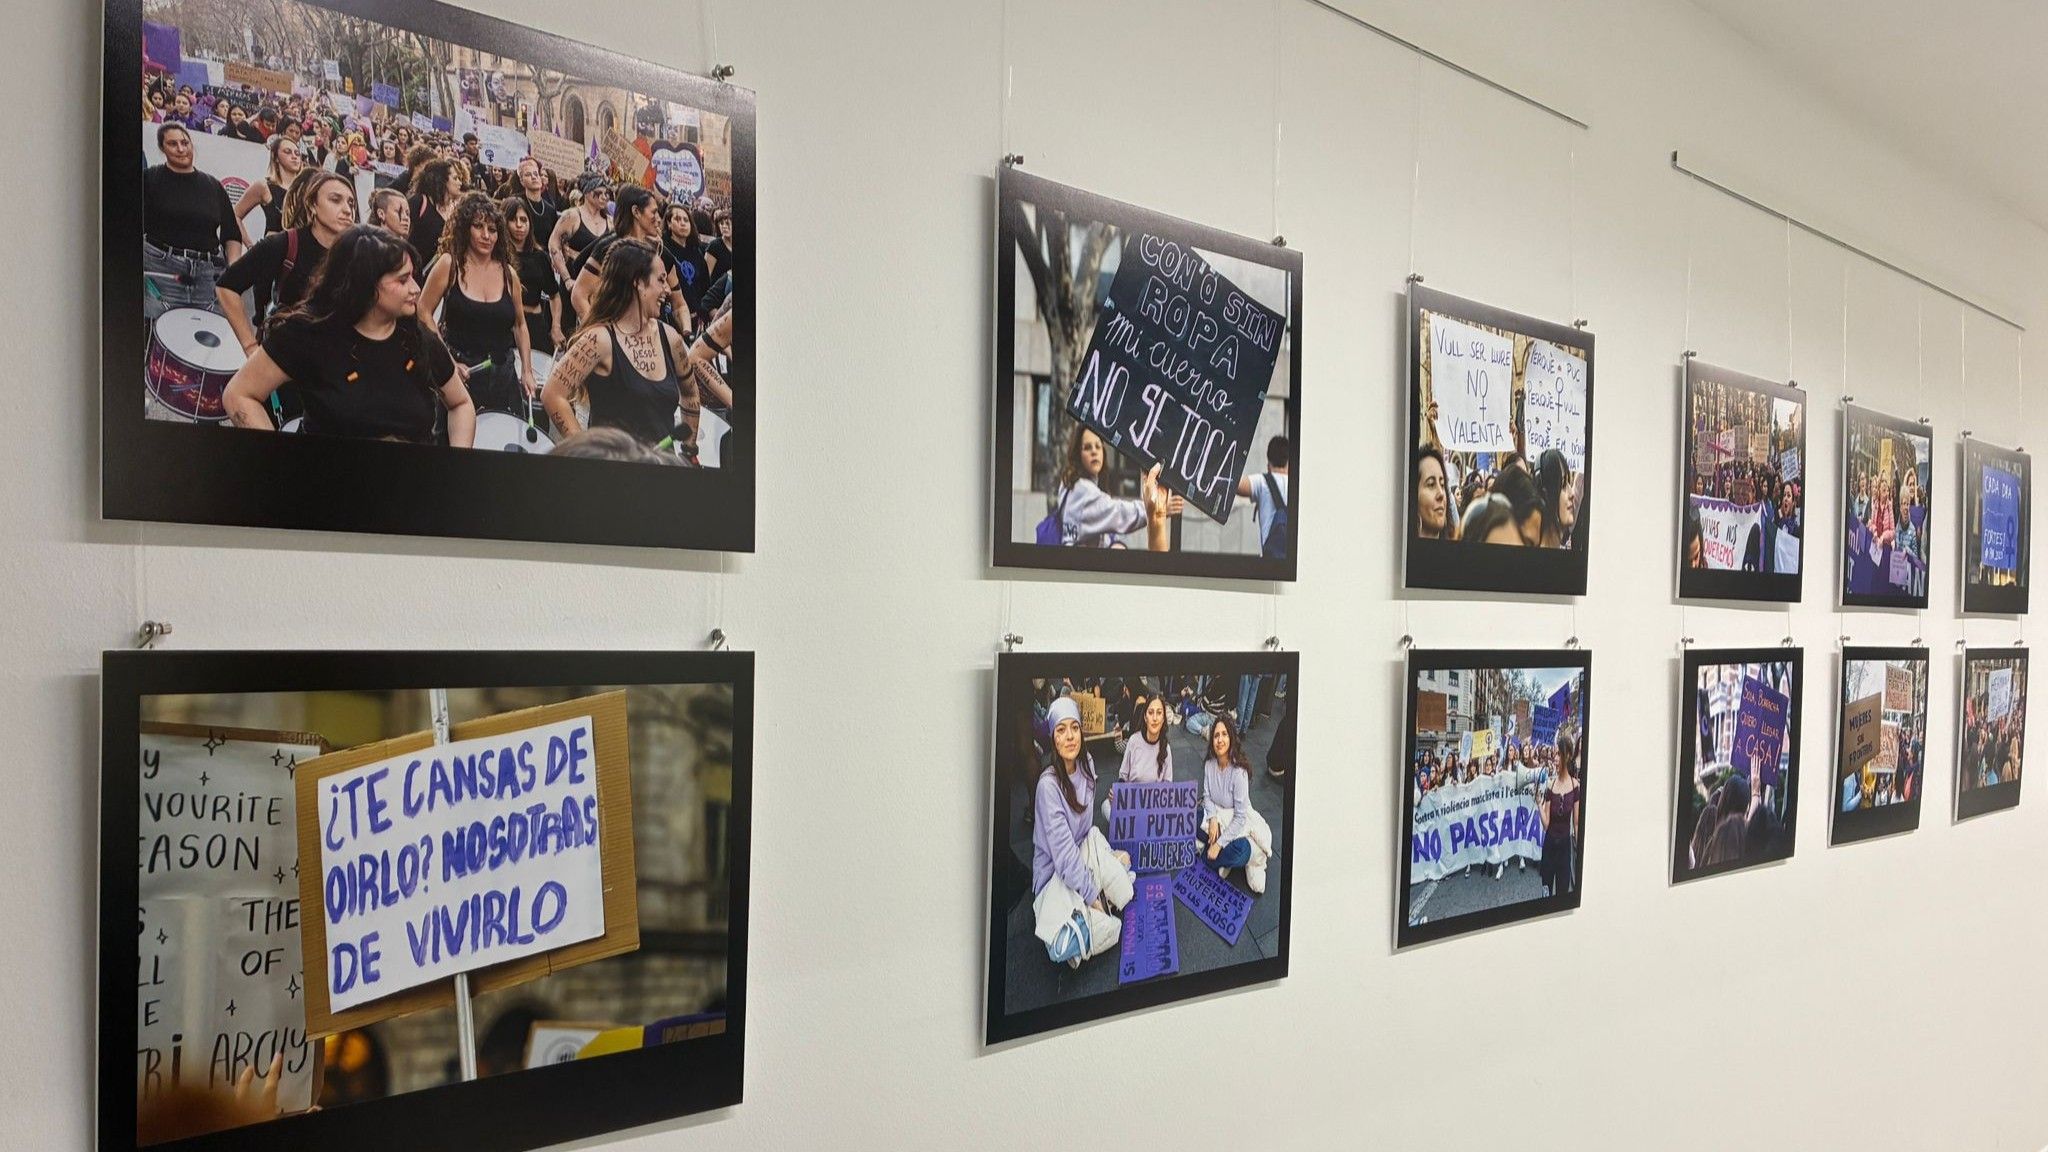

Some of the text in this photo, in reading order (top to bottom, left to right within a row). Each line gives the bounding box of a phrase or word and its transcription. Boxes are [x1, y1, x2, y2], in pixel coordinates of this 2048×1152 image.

[1140, 234, 1197, 291] CON
[1223, 292, 1277, 352] SIN
[1105, 312, 1143, 359] mi
[1141, 275, 1239, 379] ROPA
[1435, 324, 1464, 357] VULL
[1471, 341, 1486, 361] SER
[1074, 350, 1130, 428] NO
[1170, 404, 1238, 511] TOCA
[1448, 415, 1504, 446] VALENTA
[326, 727, 588, 852] ¿TE CANSAS DE
[1116, 787, 1137, 811] NI
[1114, 812, 1195, 841] NI PUTAS
[1413, 806, 1546, 864] NO PASSARA
[326, 794, 597, 924] OIRLO? NOSOTRAS
[1138, 840, 1195, 870] MUJERES
[1174, 881, 1187, 895] NO
[1202, 904, 1236, 936] ACOSO
[1182, 871, 1230, 914] MUJERES
[241, 899, 299, 934] THE
[331, 881, 568, 994] DE VIVIRLO
[240, 948, 286, 977] OF
